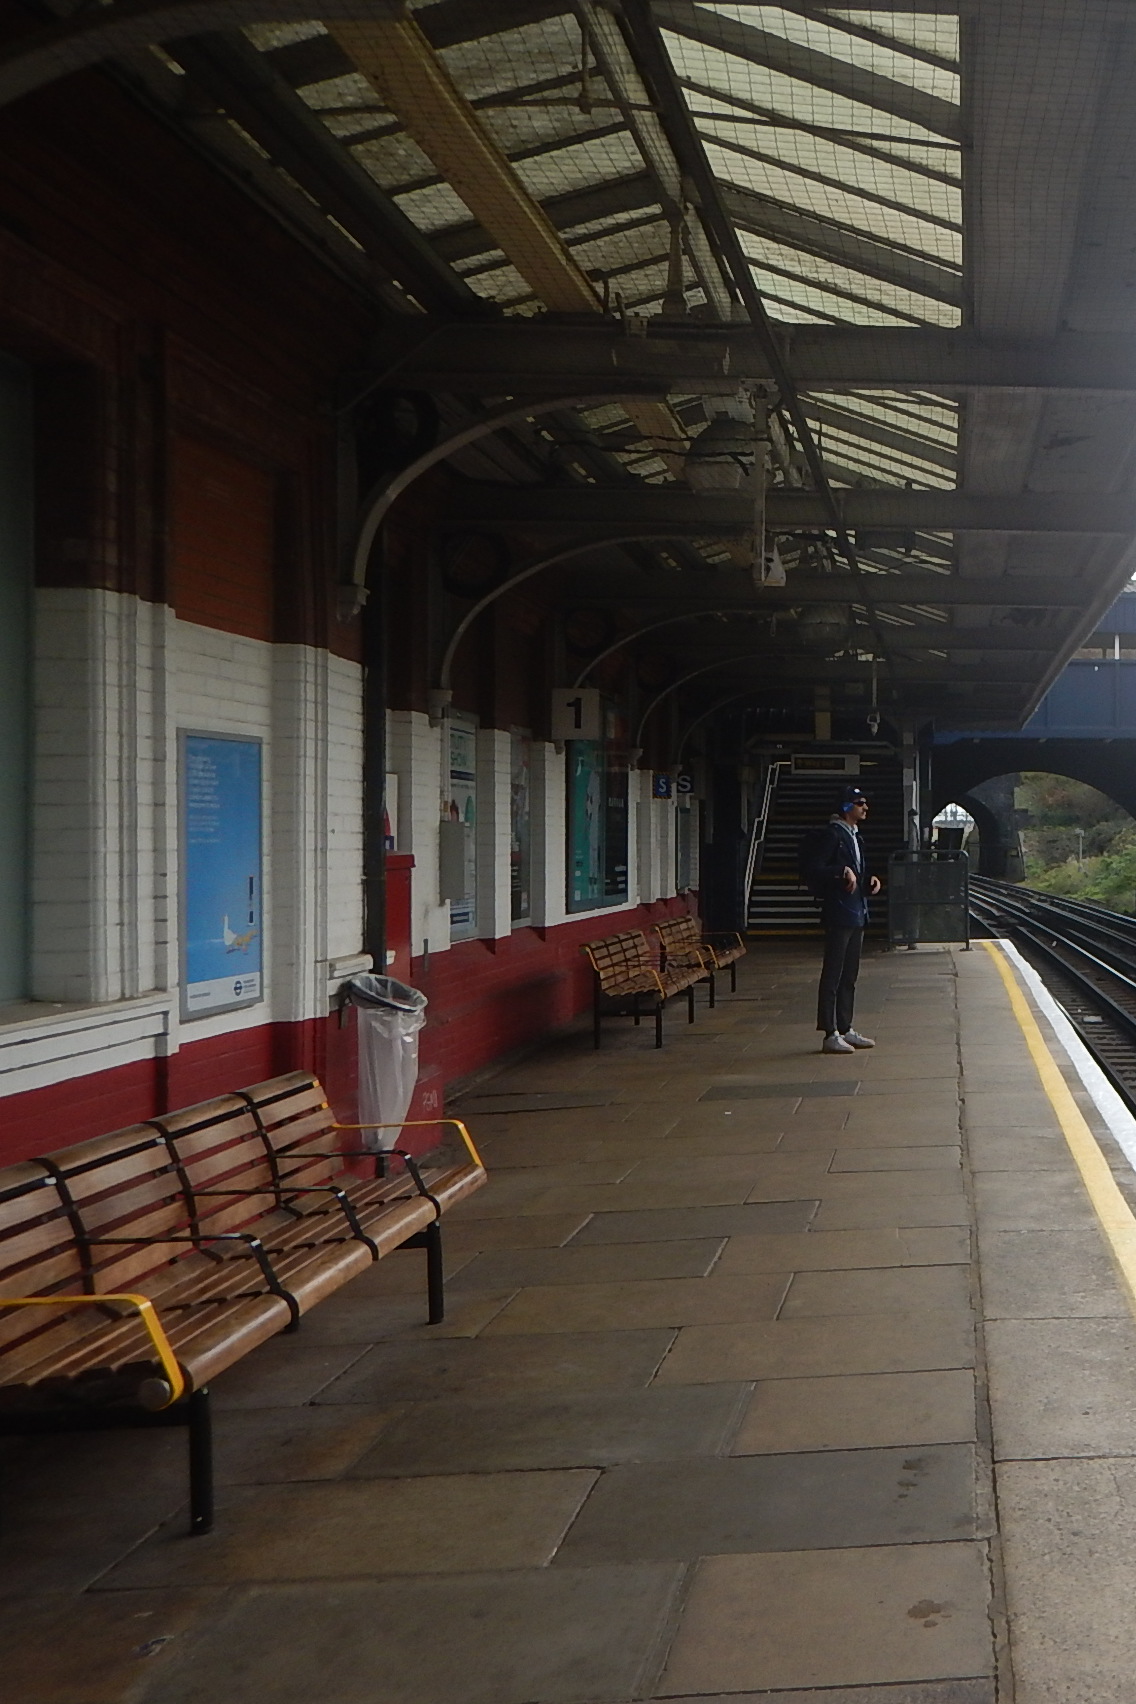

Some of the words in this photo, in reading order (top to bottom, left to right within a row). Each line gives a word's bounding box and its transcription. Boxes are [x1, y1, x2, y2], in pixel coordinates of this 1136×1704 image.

[567, 697, 582, 729] 1
[658, 778, 667, 793] S
[678, 775, 691, 792] S
